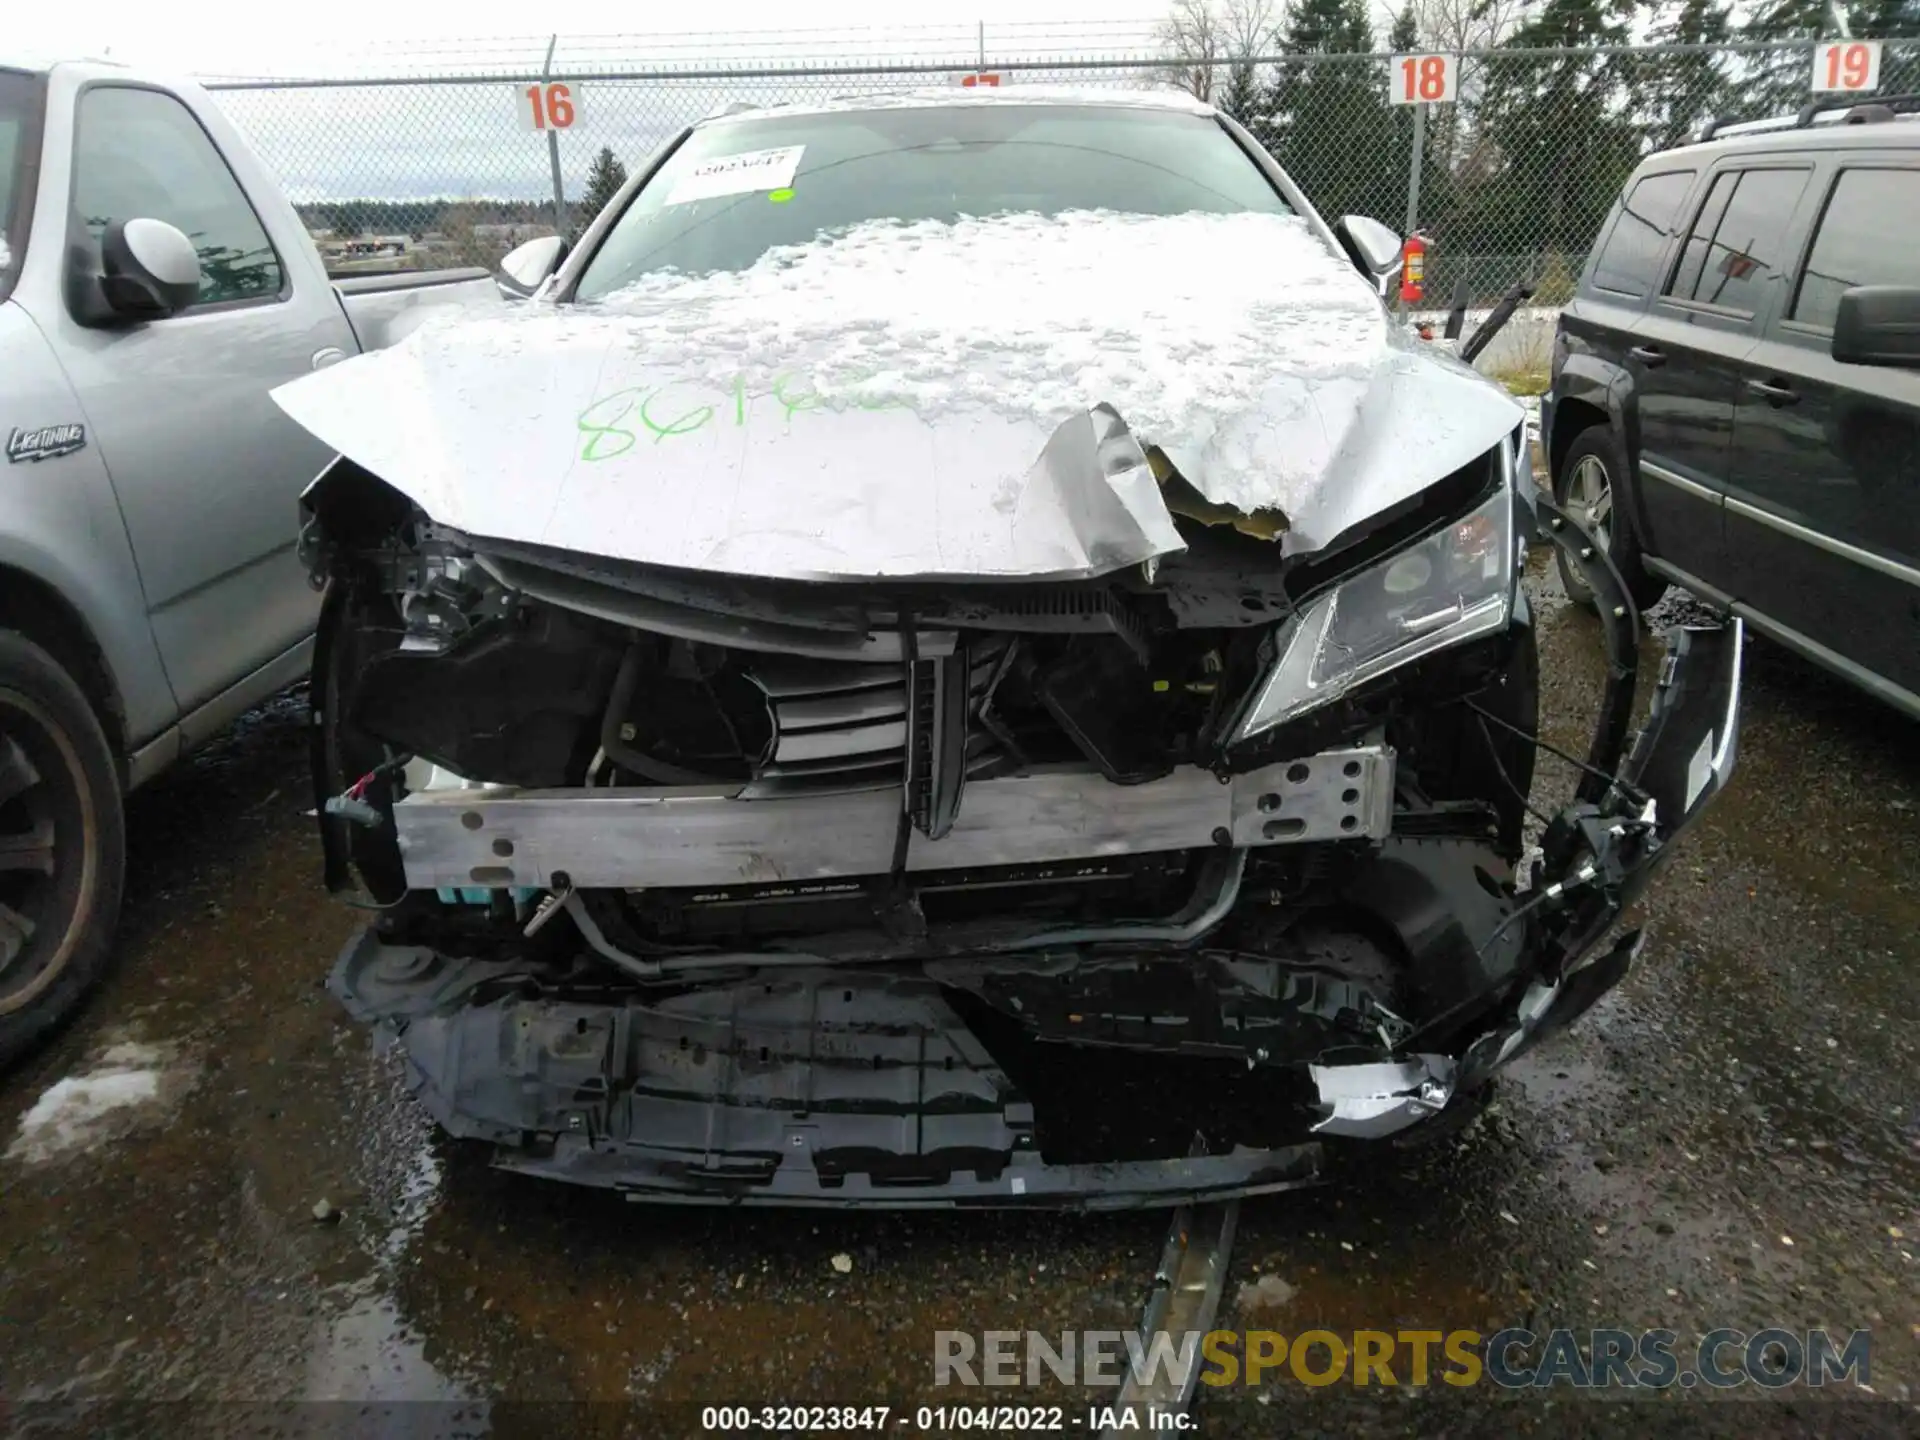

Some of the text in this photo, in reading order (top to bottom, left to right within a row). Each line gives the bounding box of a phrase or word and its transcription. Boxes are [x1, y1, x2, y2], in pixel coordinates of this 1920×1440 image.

[1402, 56, 1445, 100] 18
[1826, 44, 1869, 88] 19
[527, 84, 574, 127] 16
